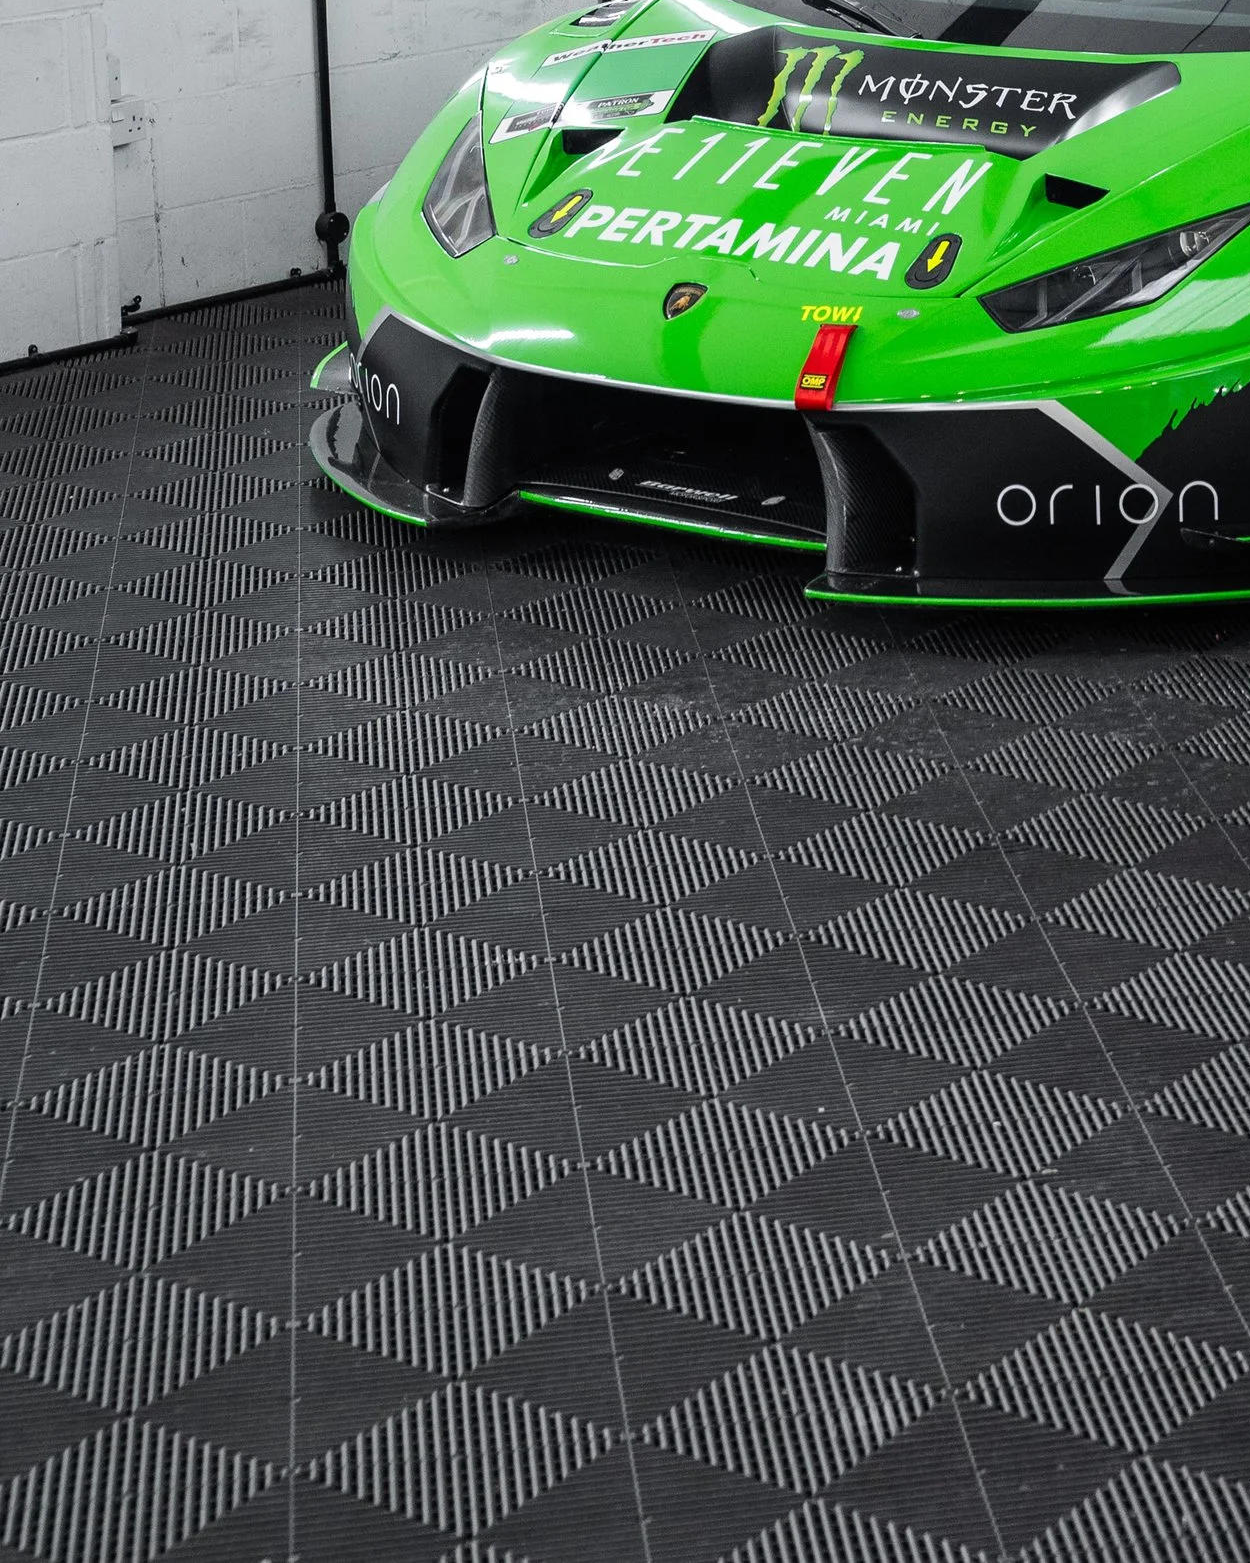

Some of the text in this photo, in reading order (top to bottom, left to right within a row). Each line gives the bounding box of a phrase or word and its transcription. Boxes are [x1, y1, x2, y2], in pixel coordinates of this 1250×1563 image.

[880, 110, 1037, 138] ENERGY
[824, 205, 939, 236] MIAMI
[562, 204, 901, 281] PERTAMINA
[801, 305, 856, 322] TOW
[802, 376, 826, 387] OMP
[997, 480, 1219, 526] orion
